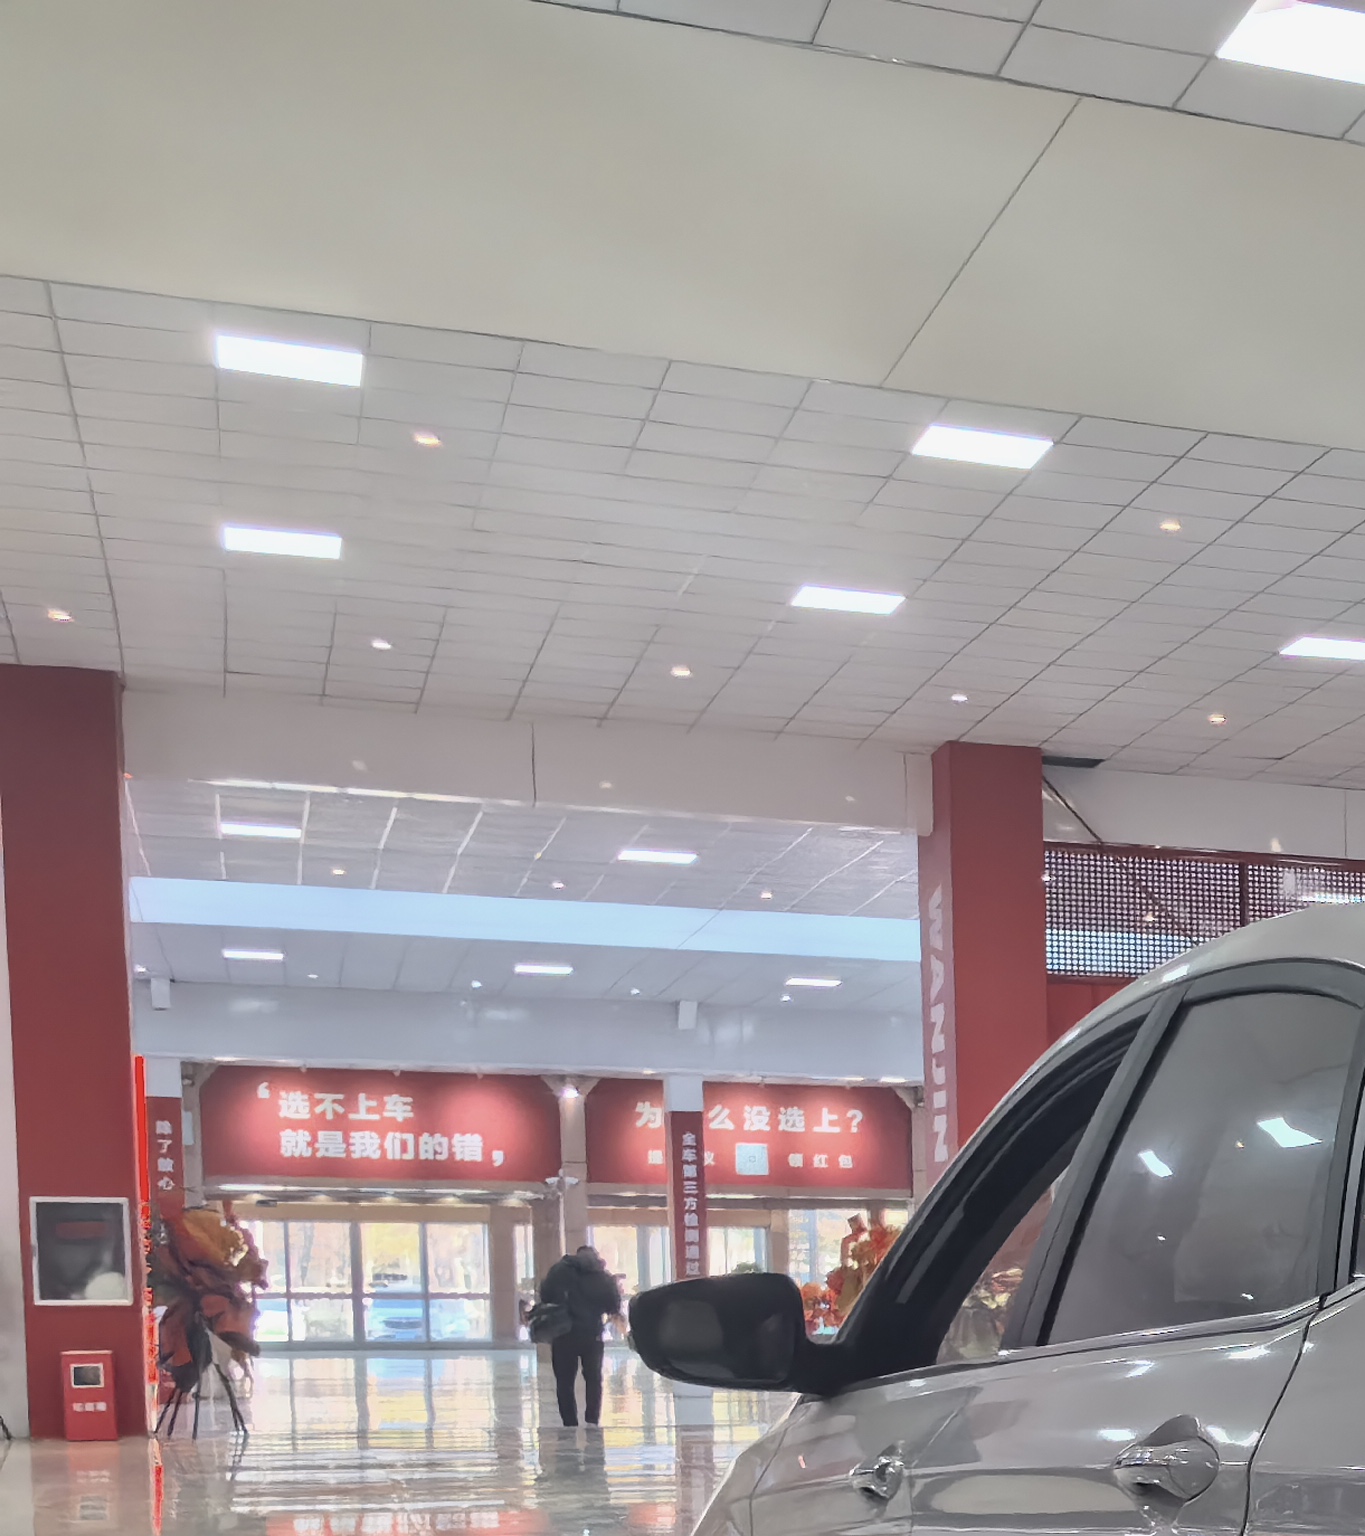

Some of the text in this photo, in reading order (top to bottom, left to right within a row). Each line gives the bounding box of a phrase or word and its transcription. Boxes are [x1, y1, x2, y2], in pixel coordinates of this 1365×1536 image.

[929, 884, 948, 1162] WANJIN
[635, 1101, 864, 1134] 为么没选上？
